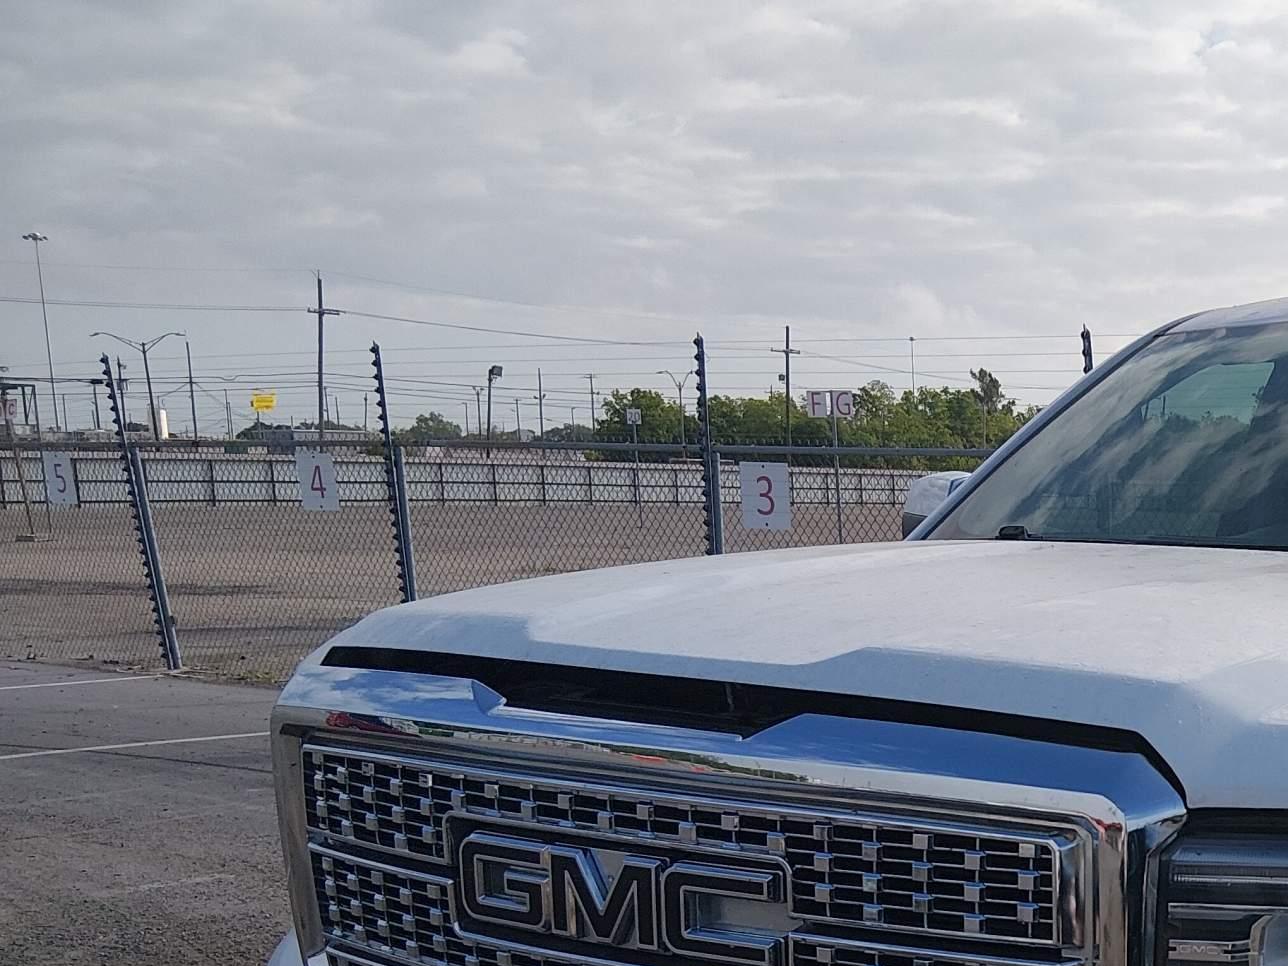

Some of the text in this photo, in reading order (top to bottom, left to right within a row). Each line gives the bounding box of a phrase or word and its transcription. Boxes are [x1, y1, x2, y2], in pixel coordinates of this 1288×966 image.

[811, 391, 851, 416] F G
[54, 463, 67, 493] 5
[311, 465, 327, 499] 4
[756, 475, 775, 515] 3
[1180, 943, 1218, 955] GMC
